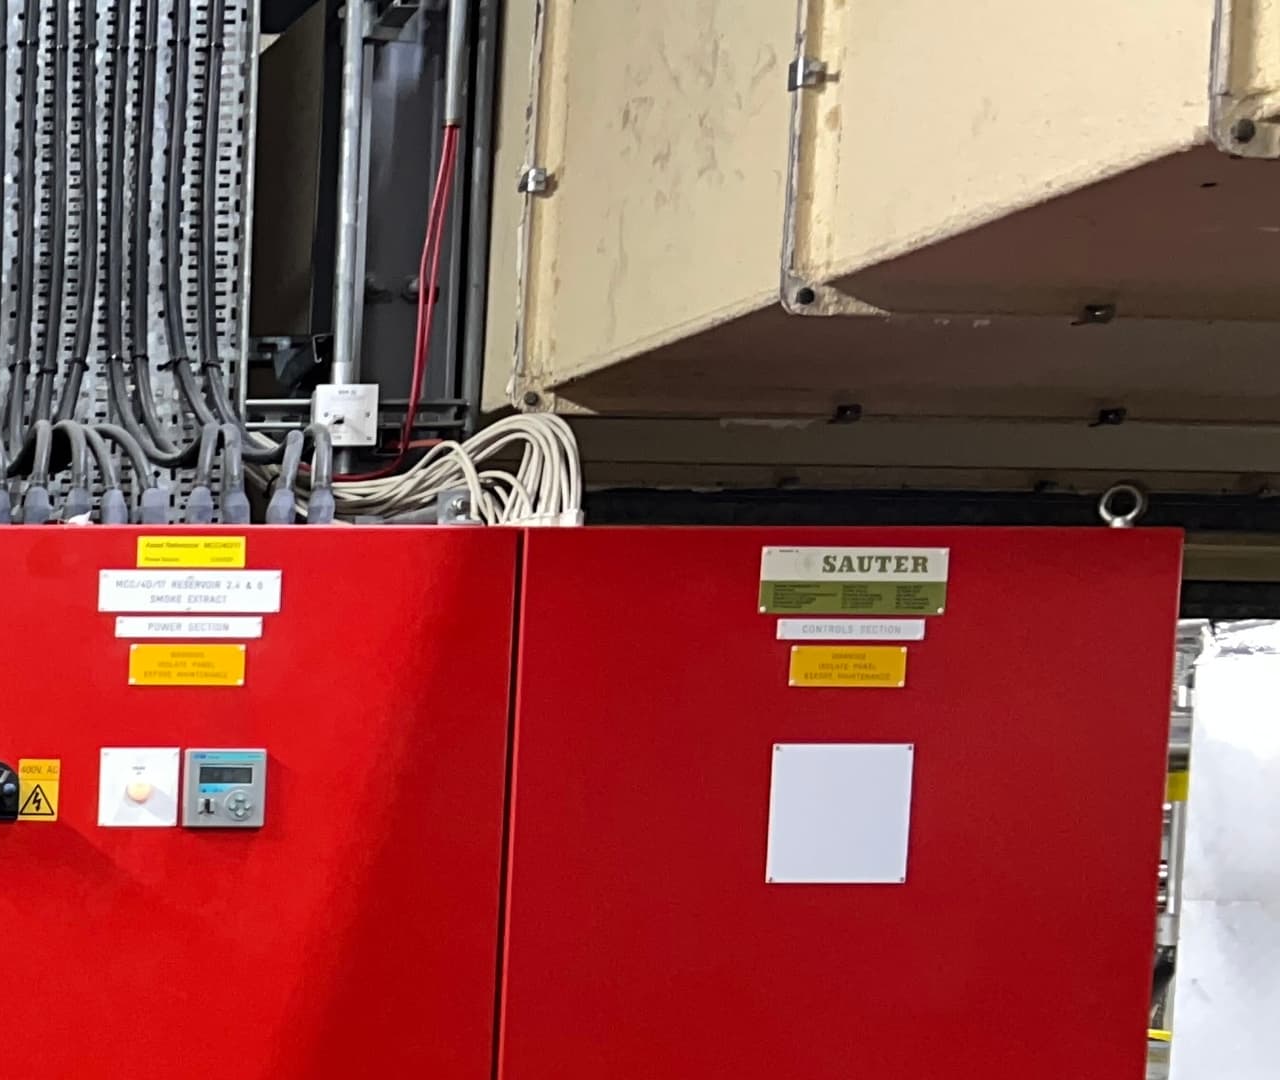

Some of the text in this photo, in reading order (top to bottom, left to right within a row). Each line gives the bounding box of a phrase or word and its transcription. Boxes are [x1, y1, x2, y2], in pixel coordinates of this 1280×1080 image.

[822, 555, 928, 573] SAUTER
[171, 580, 221, 589] RESERVOIR
[149, 594, 227, 604] SMOKE EXTRACT
[147, 622, 229, 632] POWER SECTION
[801, 624, 901, 634] CONTROLS SECTION
